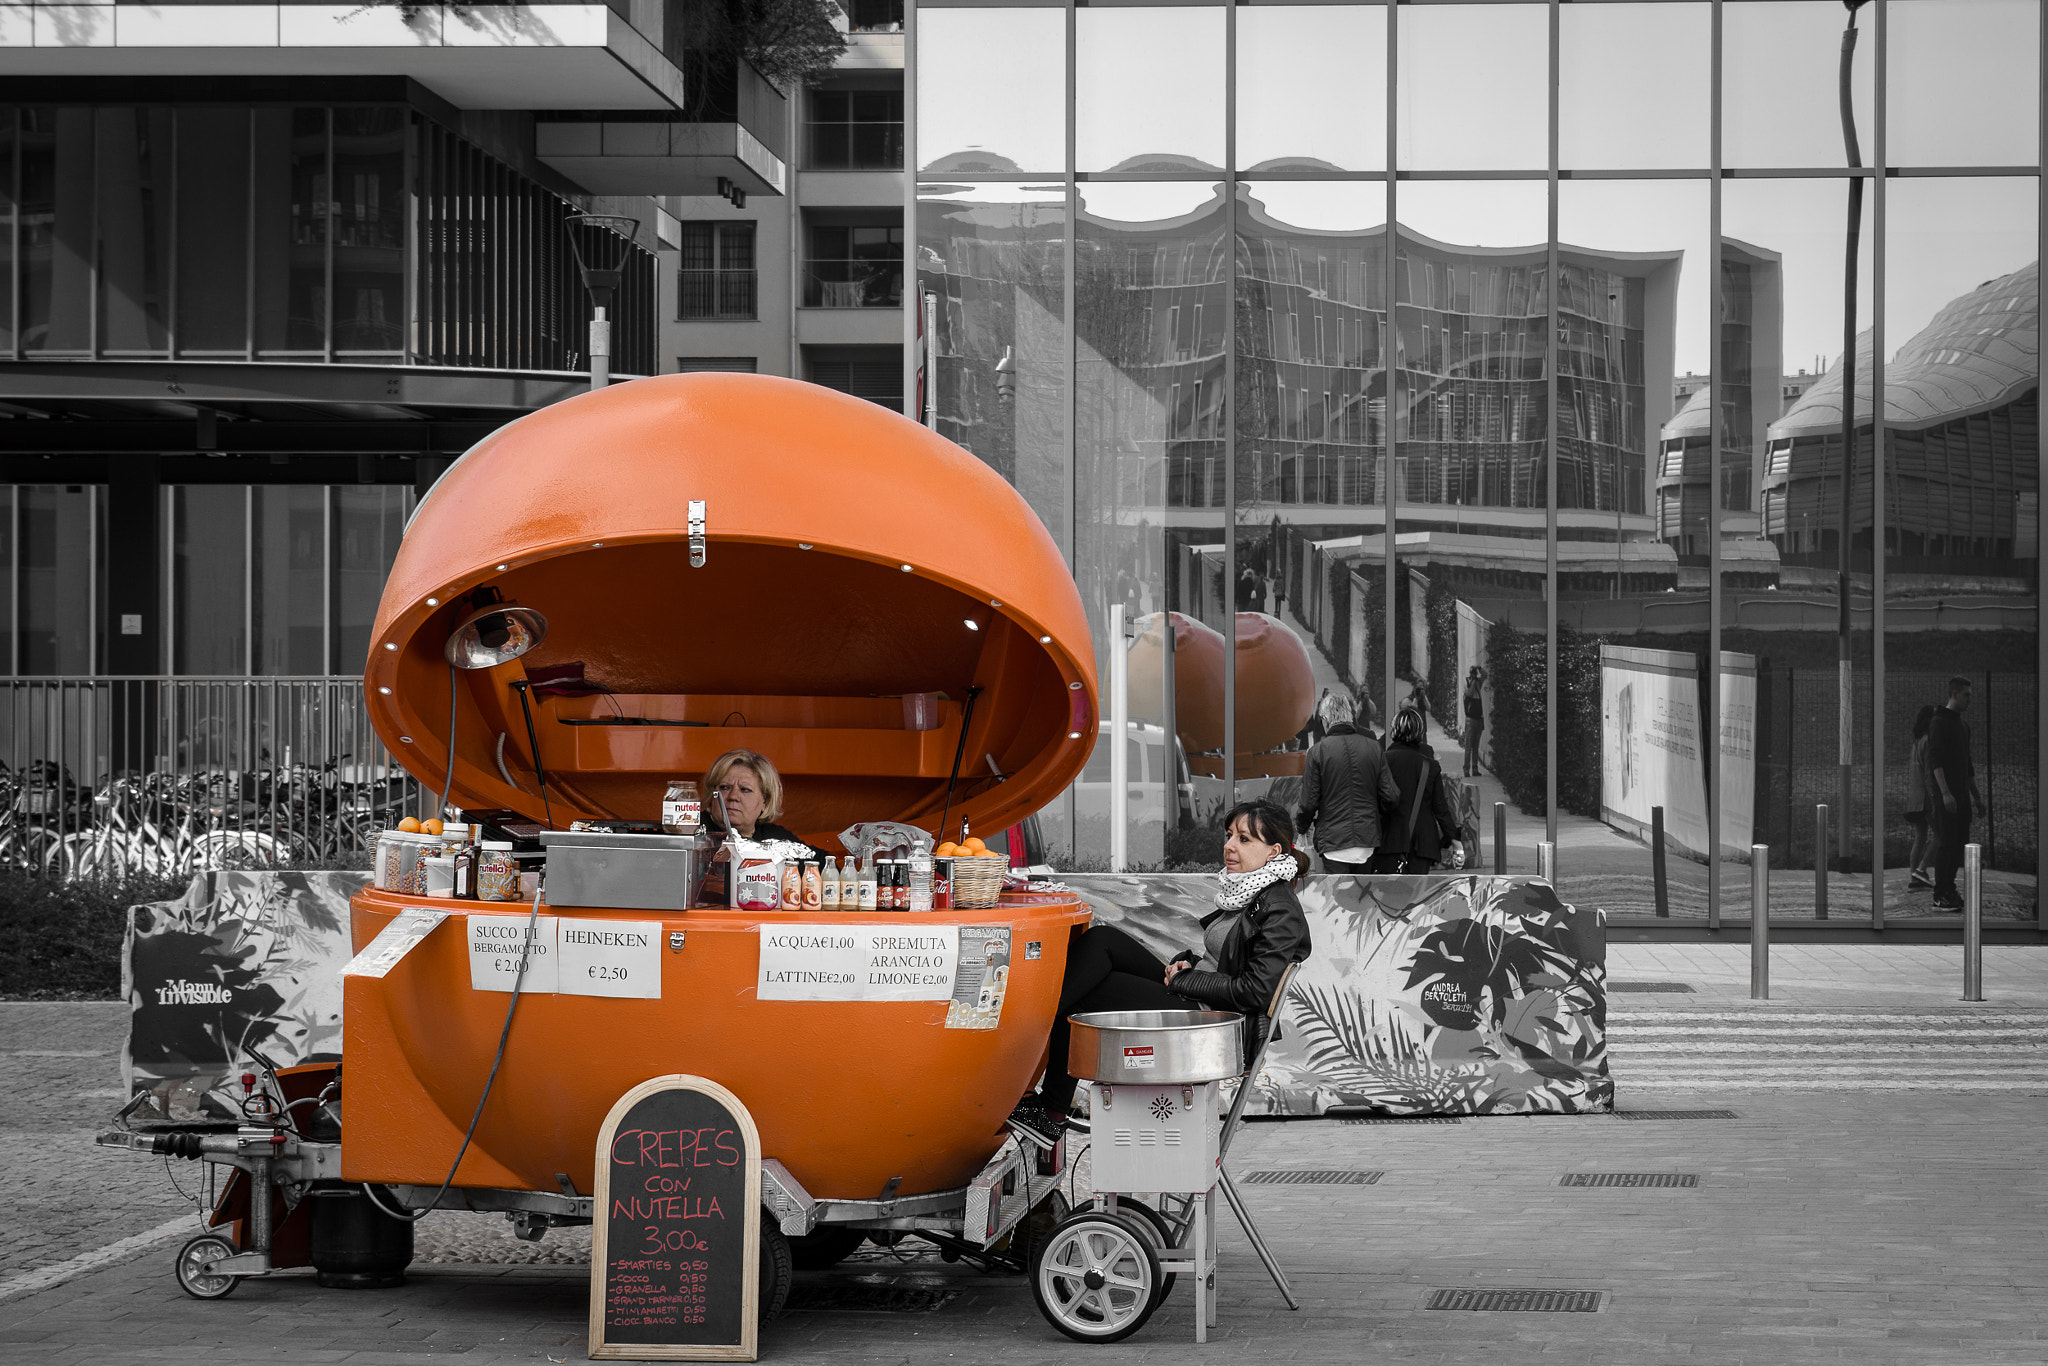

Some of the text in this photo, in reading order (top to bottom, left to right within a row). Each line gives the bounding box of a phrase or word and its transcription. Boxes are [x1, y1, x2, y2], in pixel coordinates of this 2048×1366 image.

[746, 873, 775, 882] nutella
[476, 925, 518, 939] SUCCO
[565, 930, 648, 947] HEINEKEN
[872, 937, 947, 950] SPREMUTA
[870, 956, 943, 968] ARANCIA O
[600, 967, 628, 981] 2,50
[869, 973, 948, 985] LIMONE €2,00
[1431, 983, 1460, 993] ANDREA
[612, 1128, 739, 1168] CREPES
[645, 1176, 691, 1193] CON
[613, 1196, 725, 1220] NUTELLA
[680, 1260, 709, 1272] 0,50
[680, 1273, 707, 1284] 0,50
[679, 1284, 706, 1295] 0,50
[683, 1295, 706, 1304] 0,50
[683, 1305, 707, 1314] 0,50
[683, 1315, 705, 1324] 0,50
